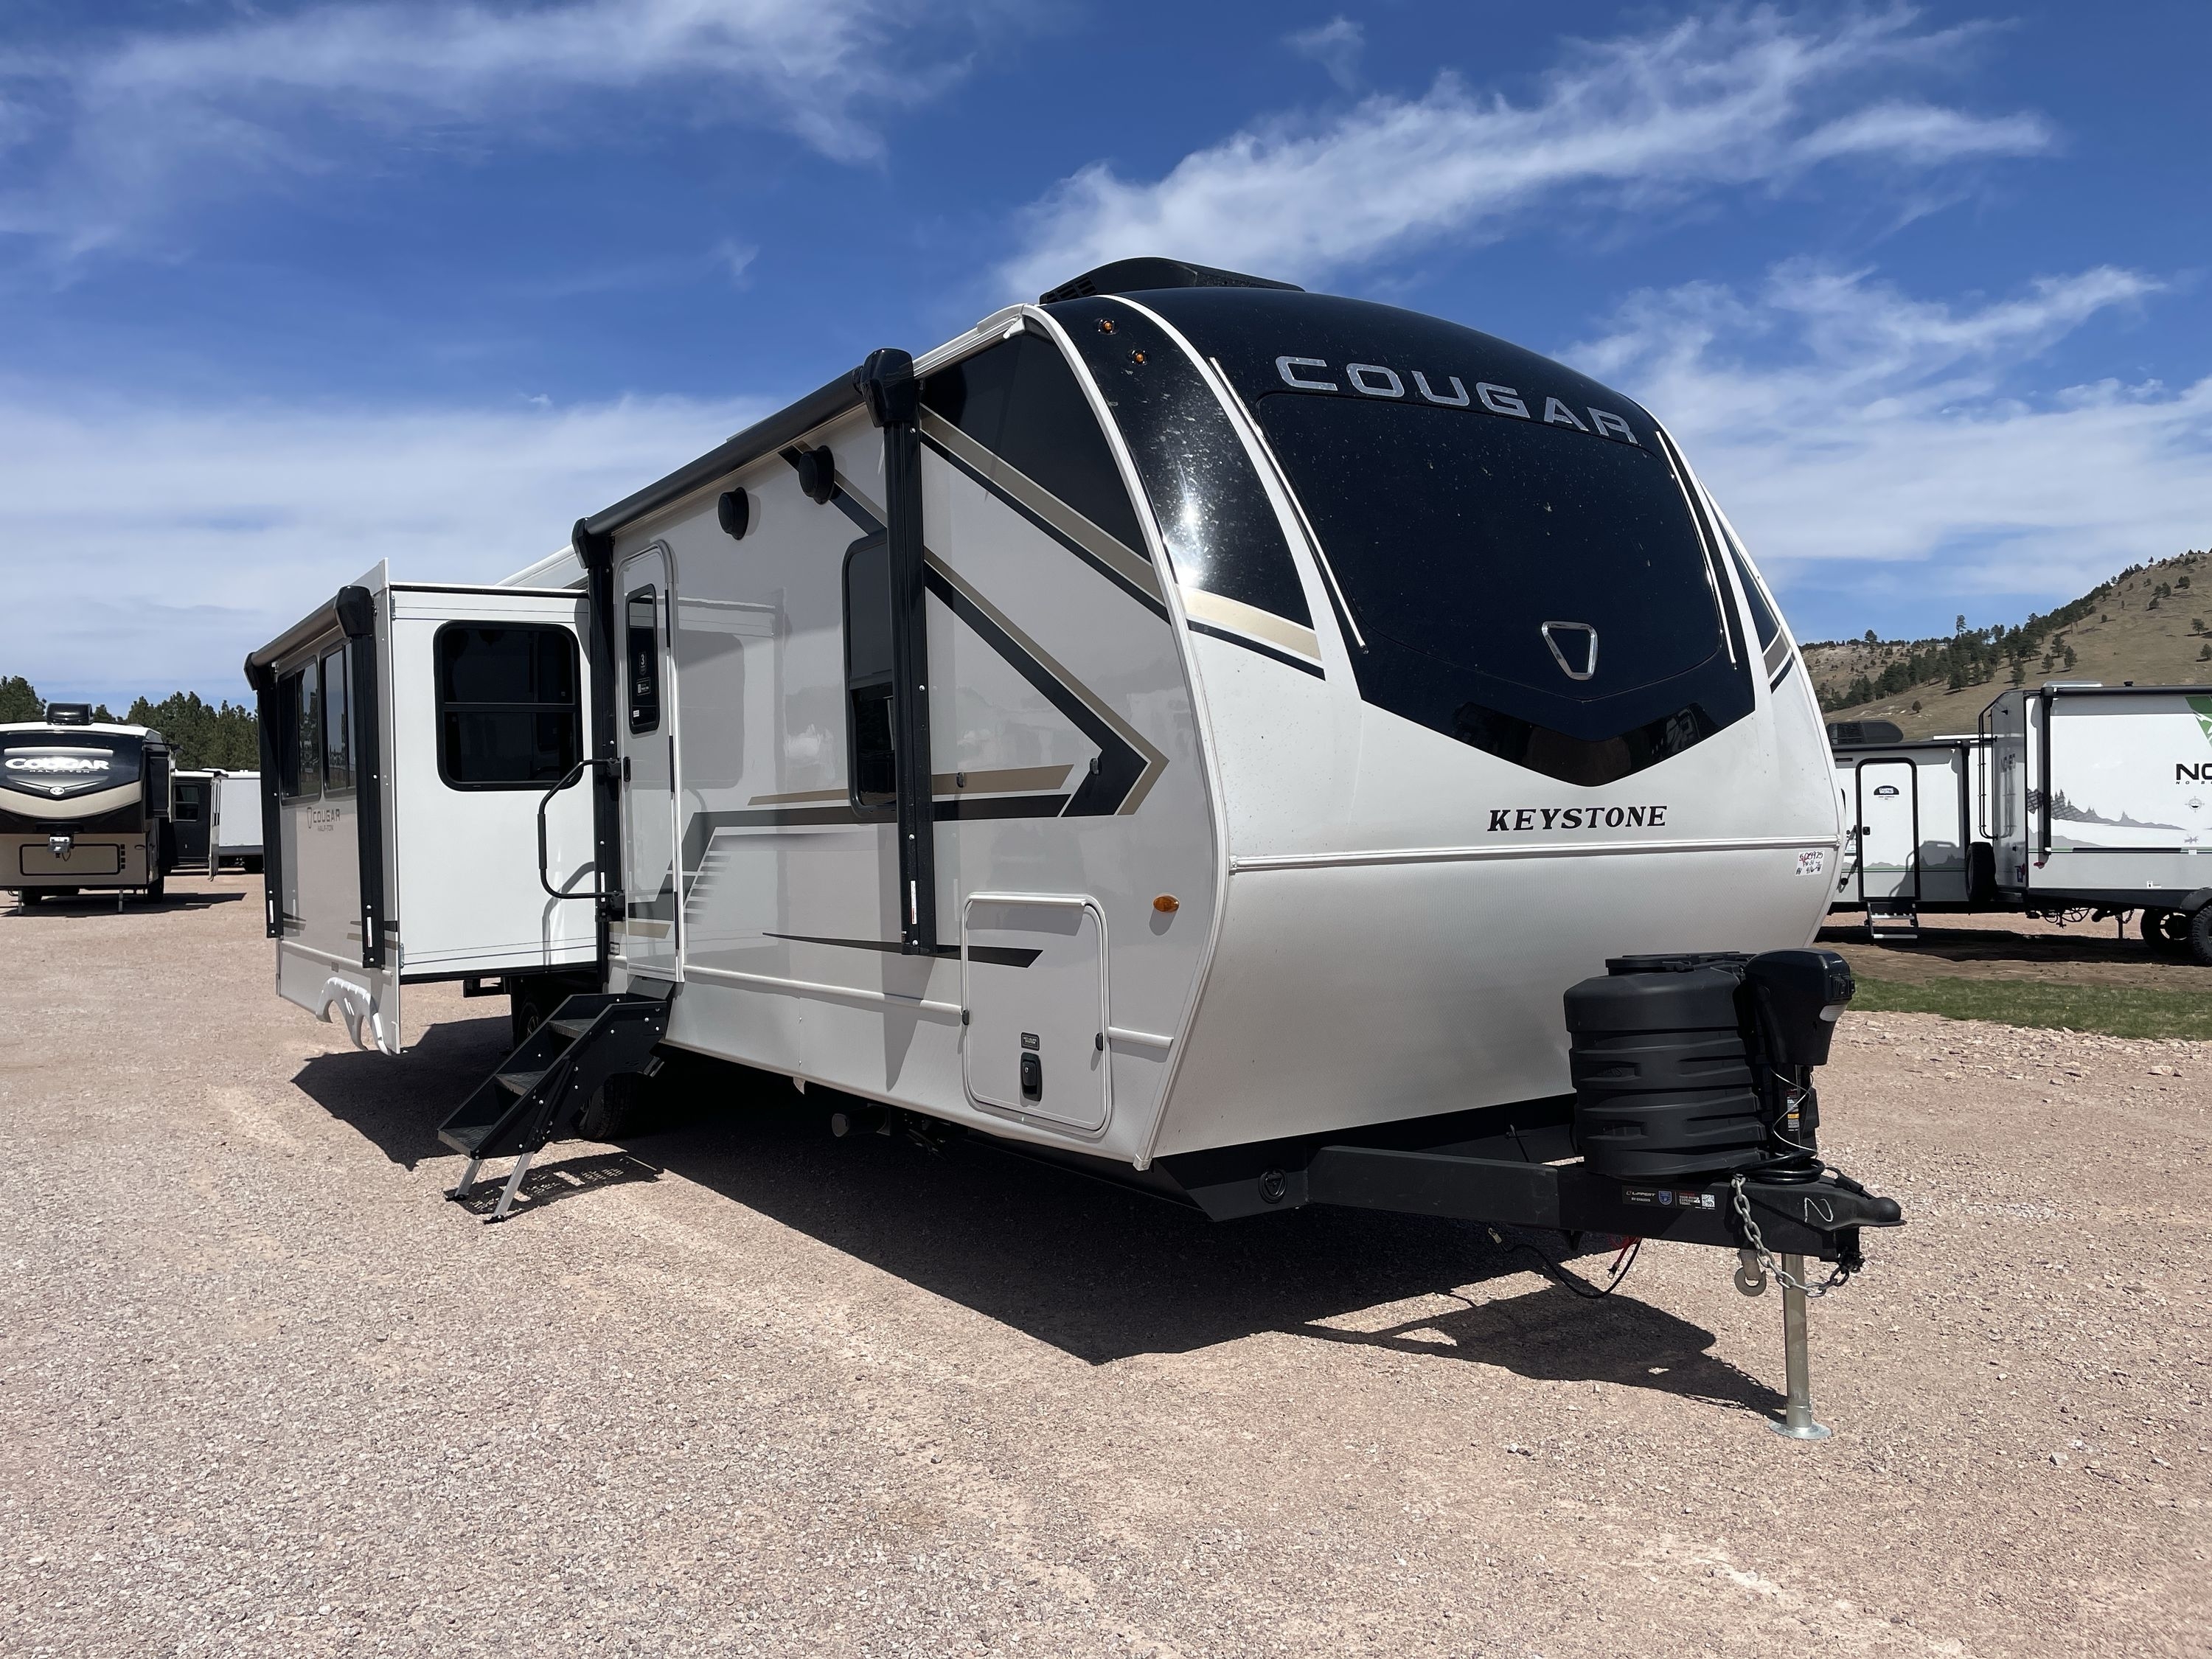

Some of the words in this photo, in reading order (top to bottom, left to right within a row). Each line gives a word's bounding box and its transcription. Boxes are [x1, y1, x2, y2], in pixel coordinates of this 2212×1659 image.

[1276, 356, 1638, 444] COUGAR
[5, 757, 110, 770] COUGAR
[313, 808, 340, 824] COUGAR
[1487, 805, 1667, 832] KEYSTONE
